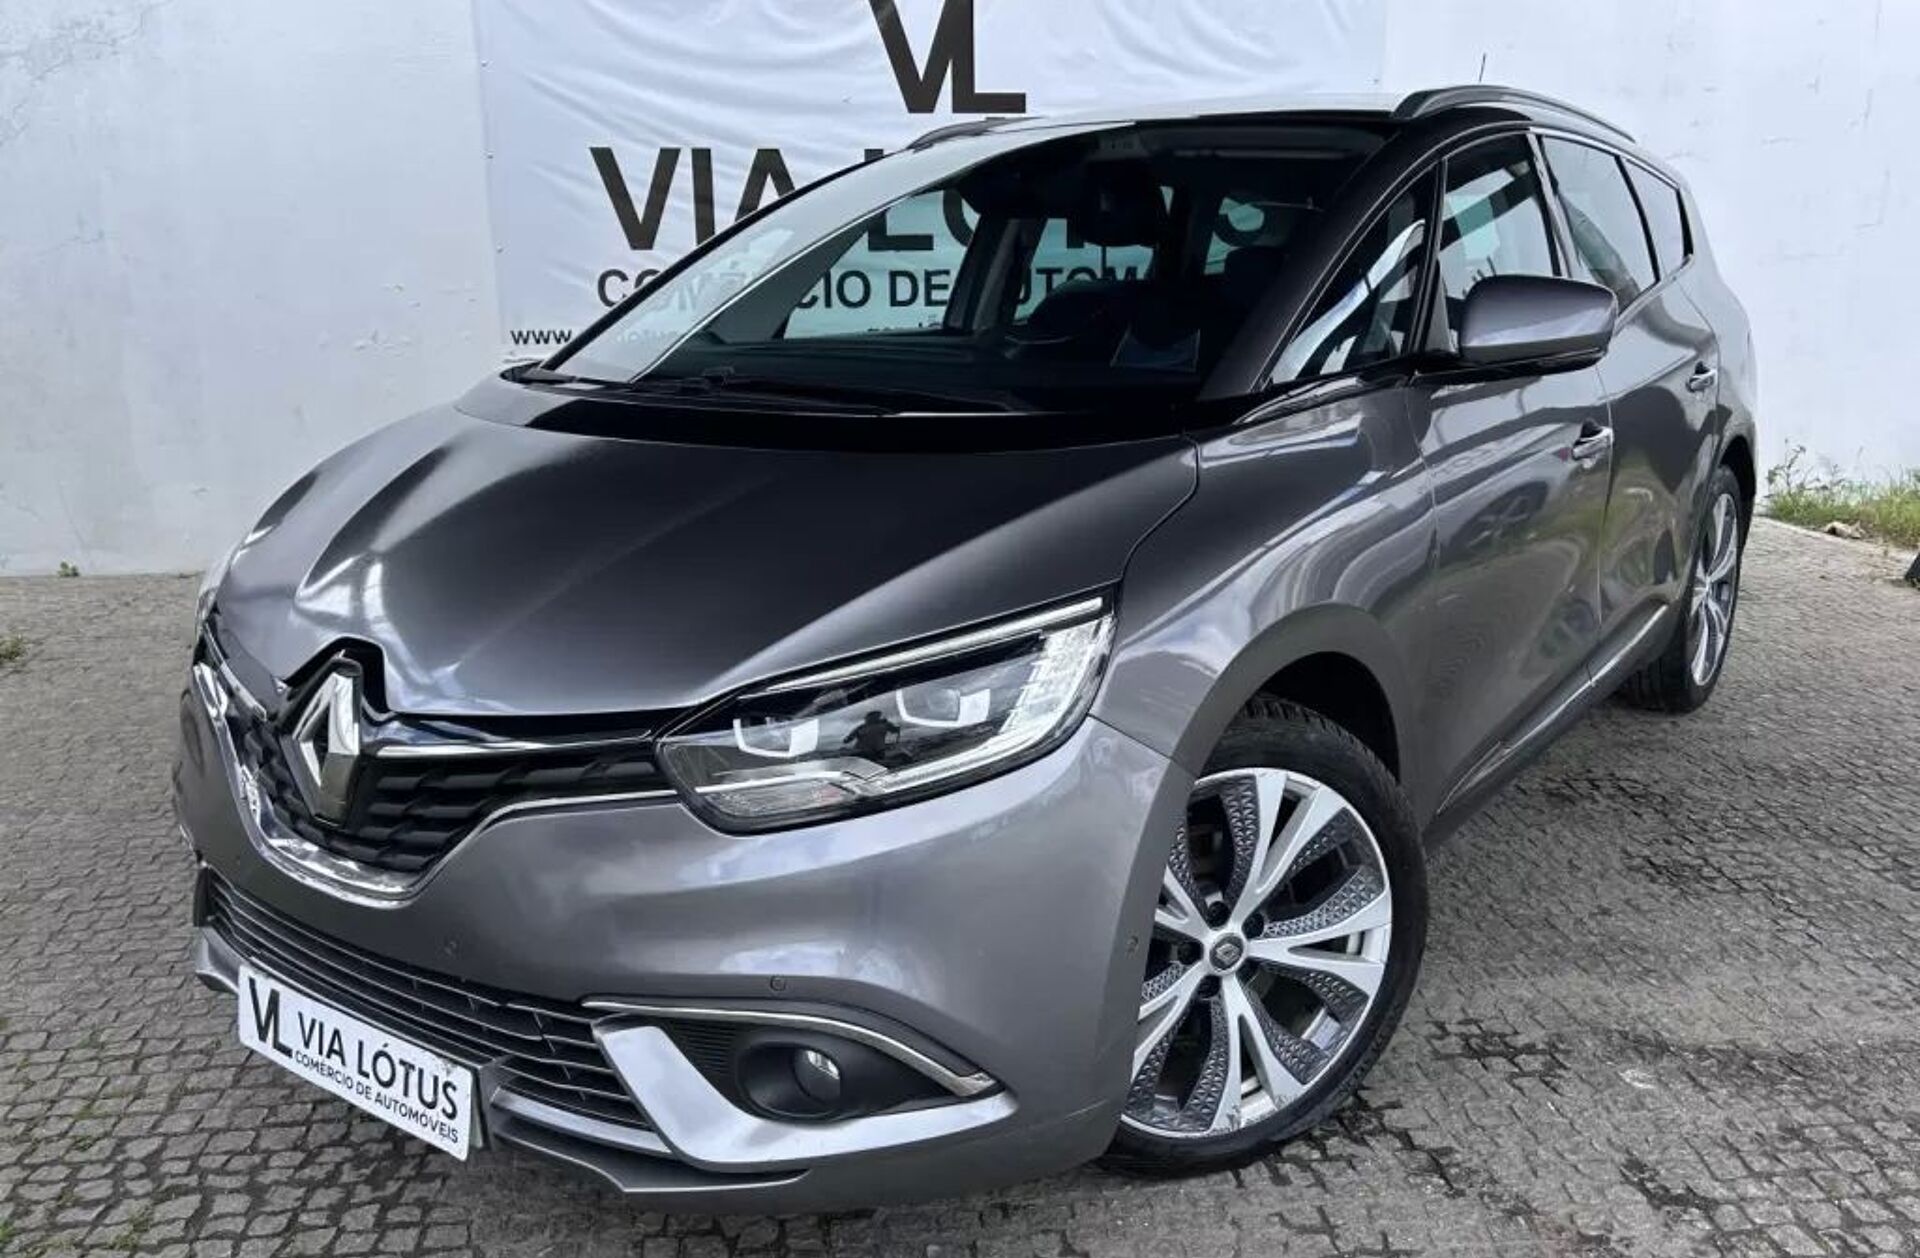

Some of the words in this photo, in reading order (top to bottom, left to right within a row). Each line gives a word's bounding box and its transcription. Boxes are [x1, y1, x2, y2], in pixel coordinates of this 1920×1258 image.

[868, 0, 1026, 113] VL
[590, 147, 796, 250] VIA
[889, 269, 951, 307] DE
[298, 1011, 346, 1067] VIA
[356, 1081, 372, 1101] DE
[374, 1091, 459, 1144] AUTOMÓVEIS
[357, 1039, 458, 1121] LÓTUS
